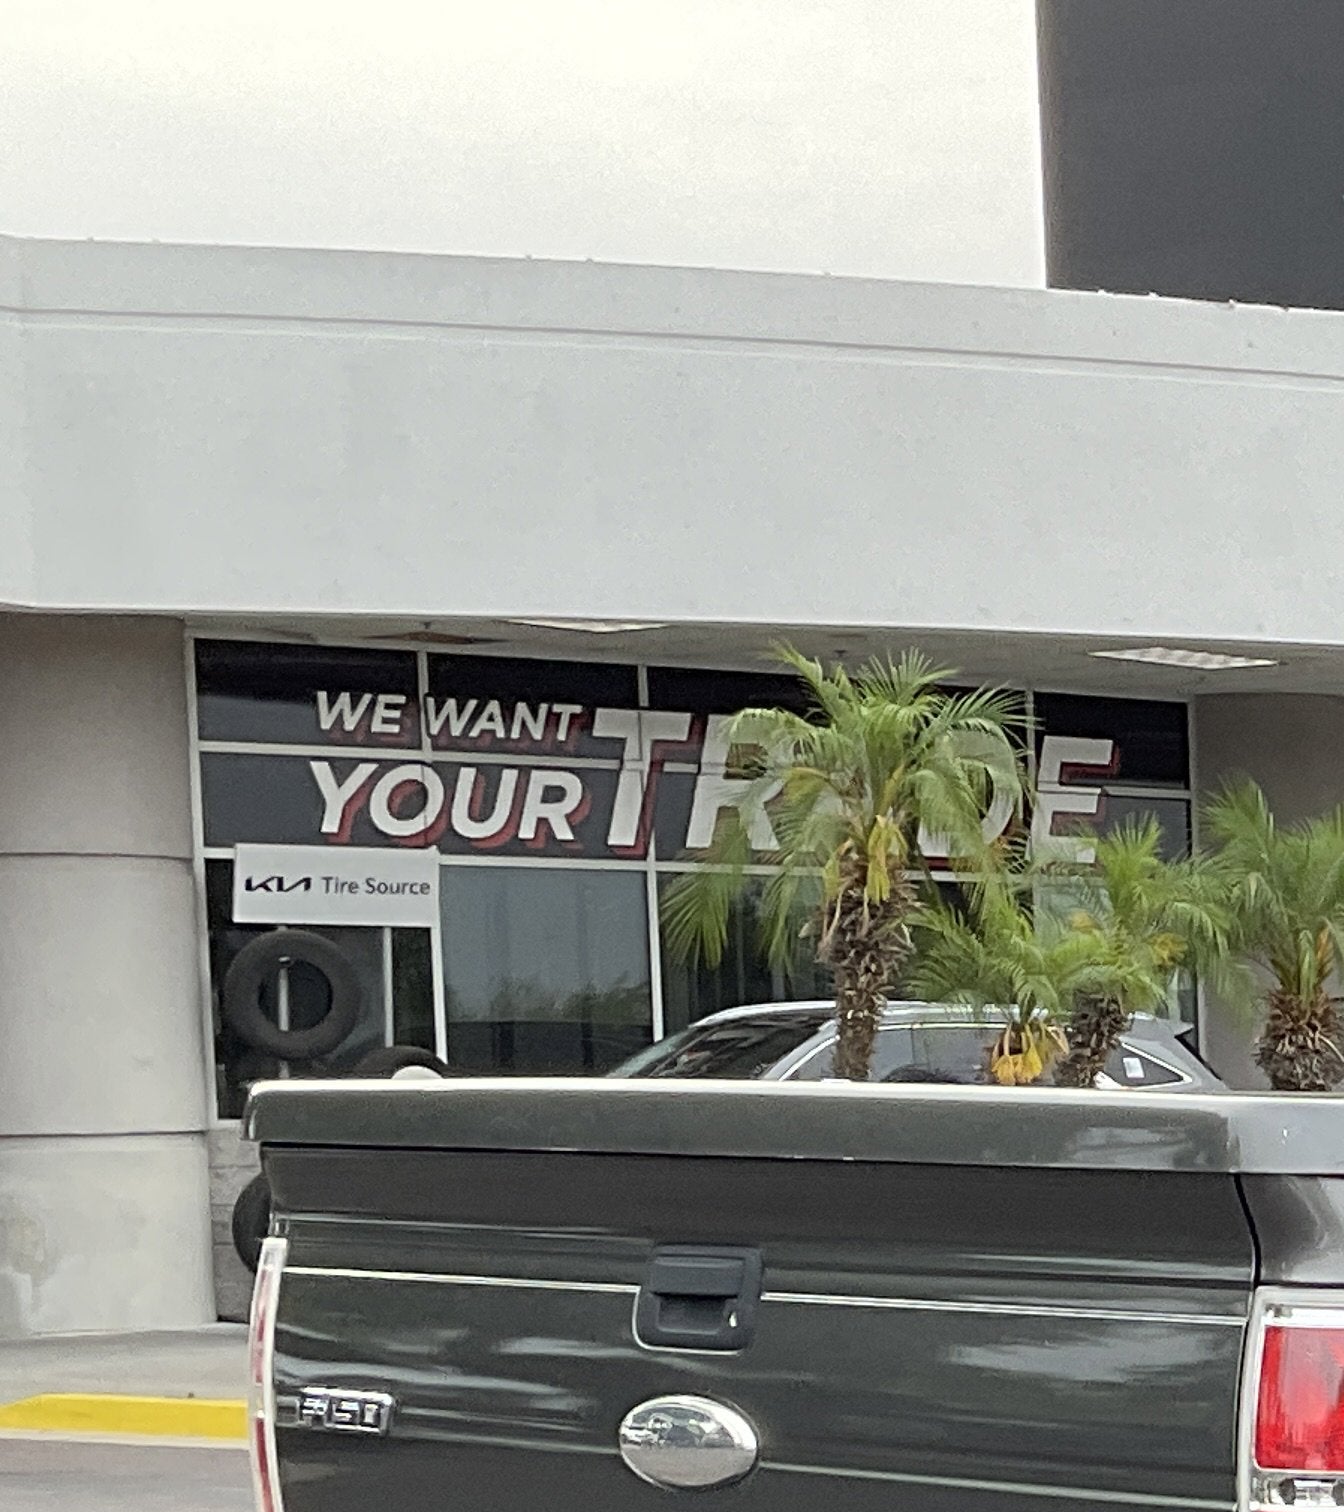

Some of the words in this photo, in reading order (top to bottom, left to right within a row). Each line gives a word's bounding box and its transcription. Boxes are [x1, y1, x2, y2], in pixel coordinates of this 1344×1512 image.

[316, 690, 407, 734] WE
[424, 696, 583, 742] WANT
[309, 760, 583, 841] YOUR
[592, 707, 1114, 864] TRDE
[245, 876, 312, 893] KIA
[322, 876, 360, 894] Tire
[365, 877, 431, 896] Source
